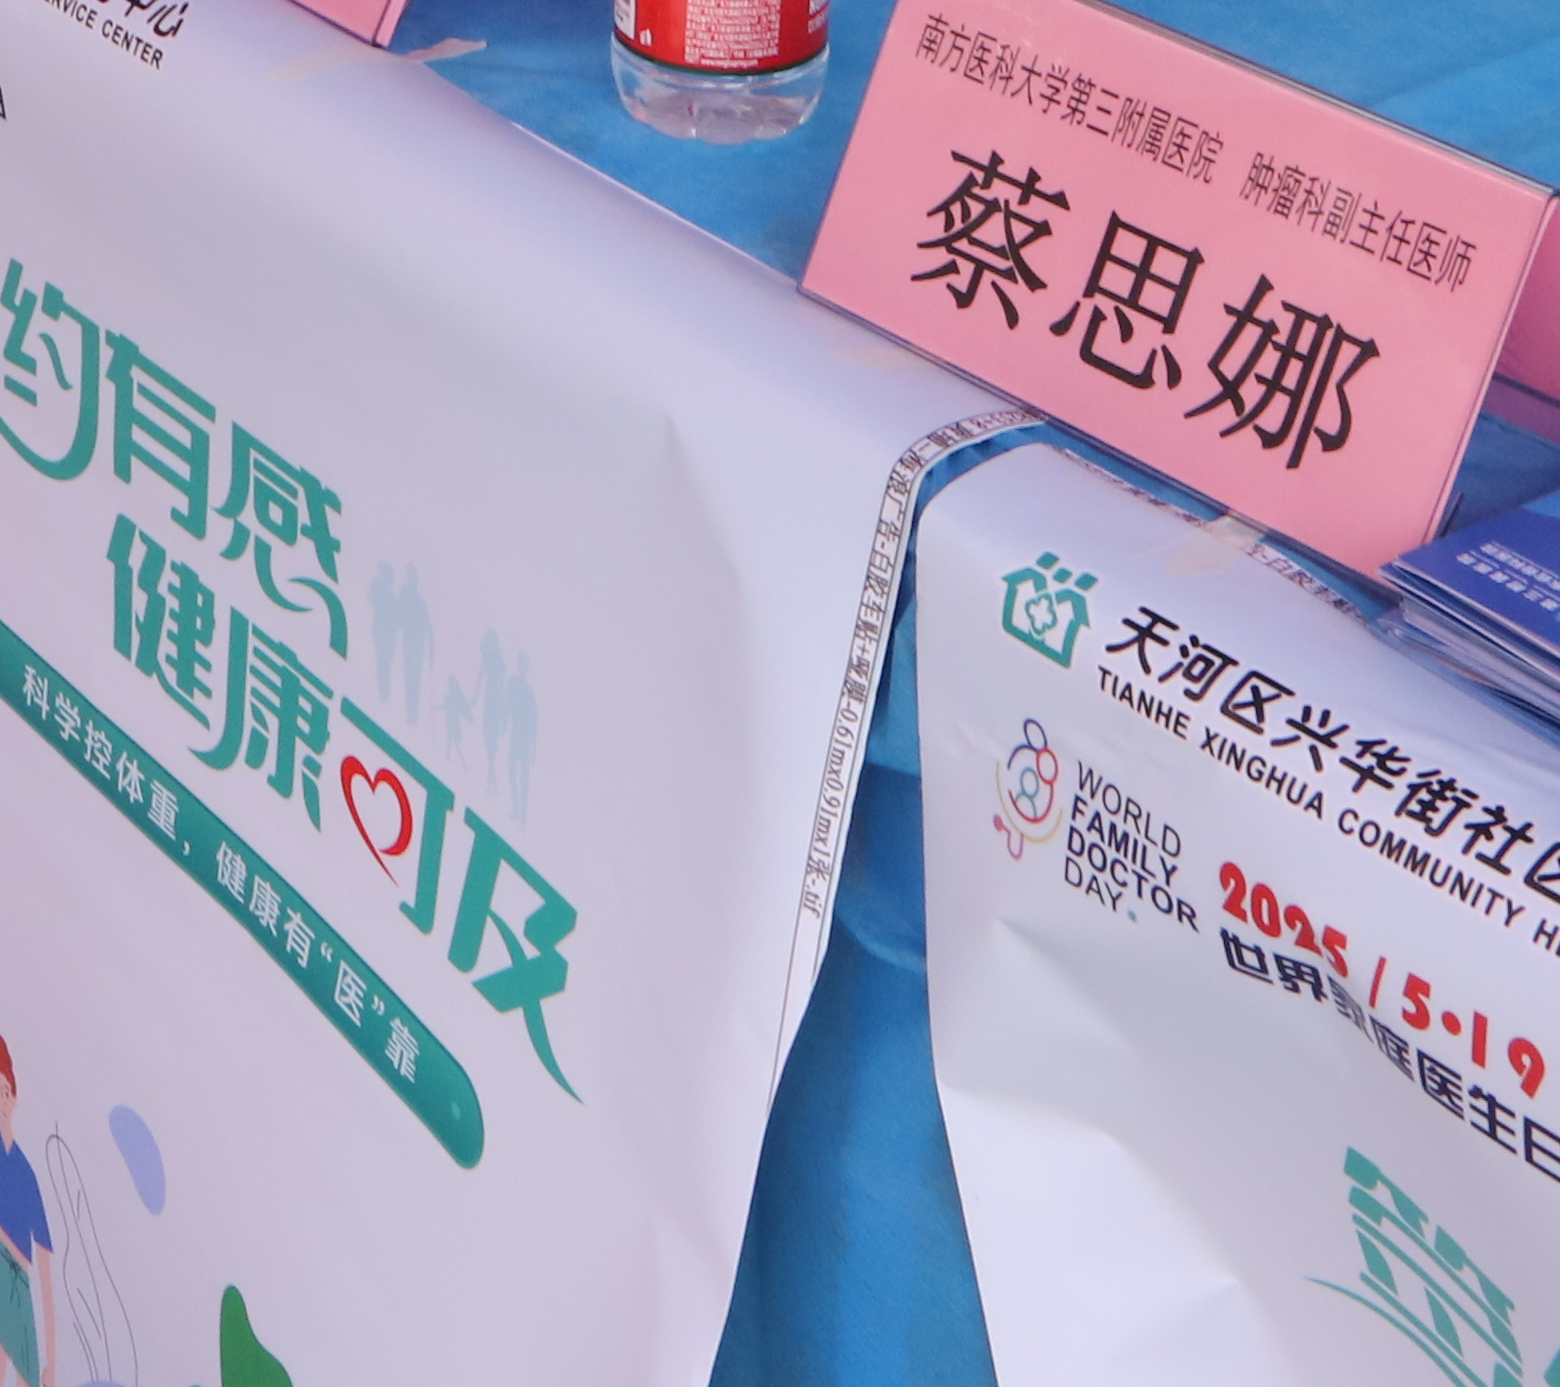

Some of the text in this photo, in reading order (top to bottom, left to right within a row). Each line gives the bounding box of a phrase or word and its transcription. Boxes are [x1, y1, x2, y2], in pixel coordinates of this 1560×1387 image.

[101, 19, 165, 71] CENTER
[913, 10, 1479, 295] 南方医科大学第三附属医院 肿瘤科副主任医师
[909, 146, 1383, 473] 蔡思娜
[106, 512, 585, 1105] 健康可及
[1071, 797, 1179, 888] FAMILY
[1077, 758, 1184, 858] WORLD
[1097, 663, 1192, 739] TIANHE
[1201, 726, 1325, 821] XINGHUA
[1338, 810, 1526, 928] COMMUNITY
[1064, 856, 1127, 913] DAY
[1067, 827, 1200, 934] DOCTOR
[1218, 860, 1350, 980] 2025
